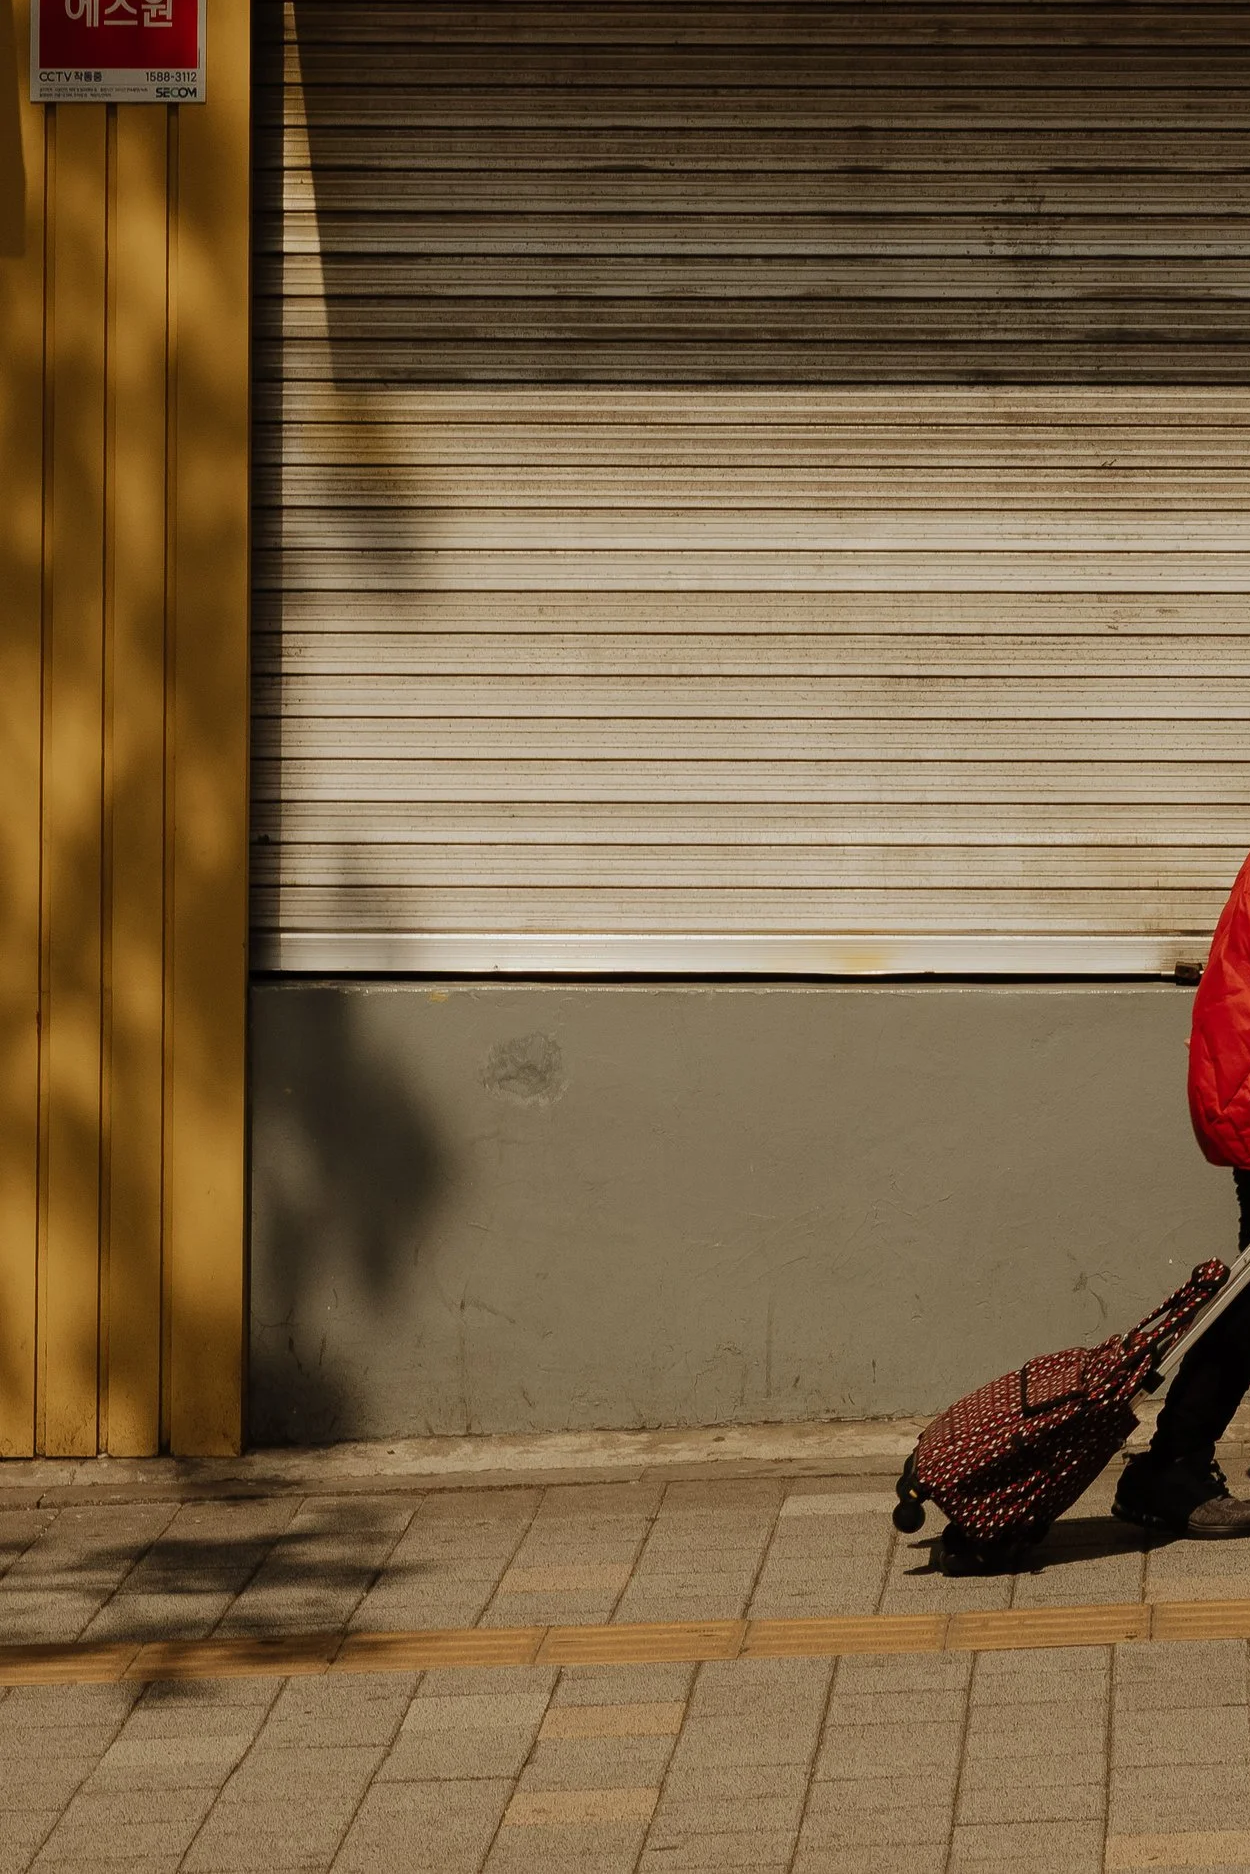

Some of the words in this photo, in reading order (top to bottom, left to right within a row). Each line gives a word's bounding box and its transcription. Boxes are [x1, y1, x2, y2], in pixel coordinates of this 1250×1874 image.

[39, 71, 72, 83] CCTV
[145, 71, 197, 83] 1588-3112
[156, 87, 197, 98] SECOM
